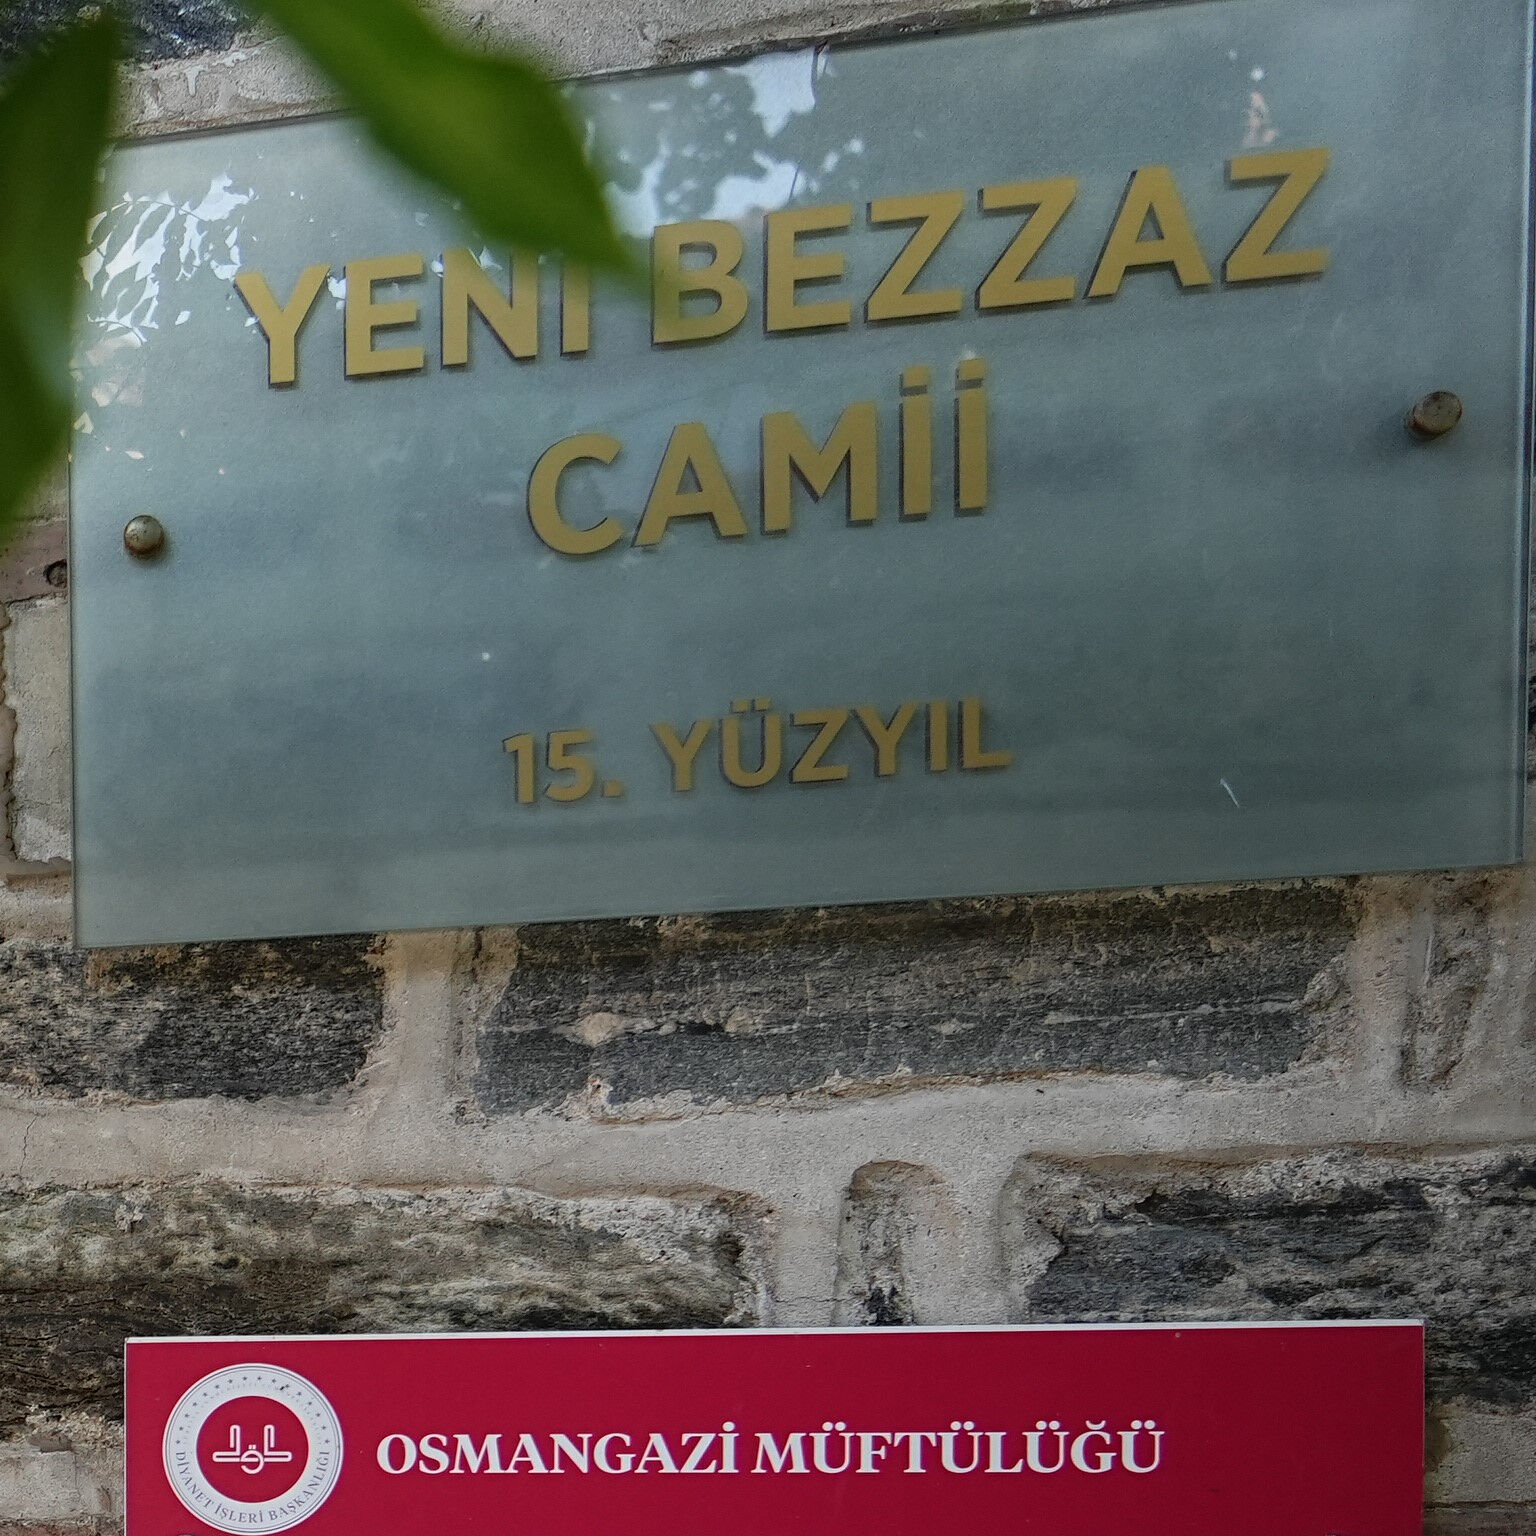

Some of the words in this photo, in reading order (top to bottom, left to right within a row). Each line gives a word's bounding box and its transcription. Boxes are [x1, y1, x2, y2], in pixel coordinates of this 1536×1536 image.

[650, 147, 1330, 347] BEZZAZ
[527, 357, 989, 555] CAMİİ
[502, 729, 624, 804] 15.
[649, 697, 1014, 793] YÜZYIL
[175, 1450, 217, 1509] DİYANET
[214, 1502, 264, 1525] İŞLERİ
[268, 1450, 331, 1522] BAŞKANLIĞI
[376, 1421, 740, 1474] OSMANGAZİ
[754, 1420, 1165, 1474] MÜFTÜLÜĞÜ
